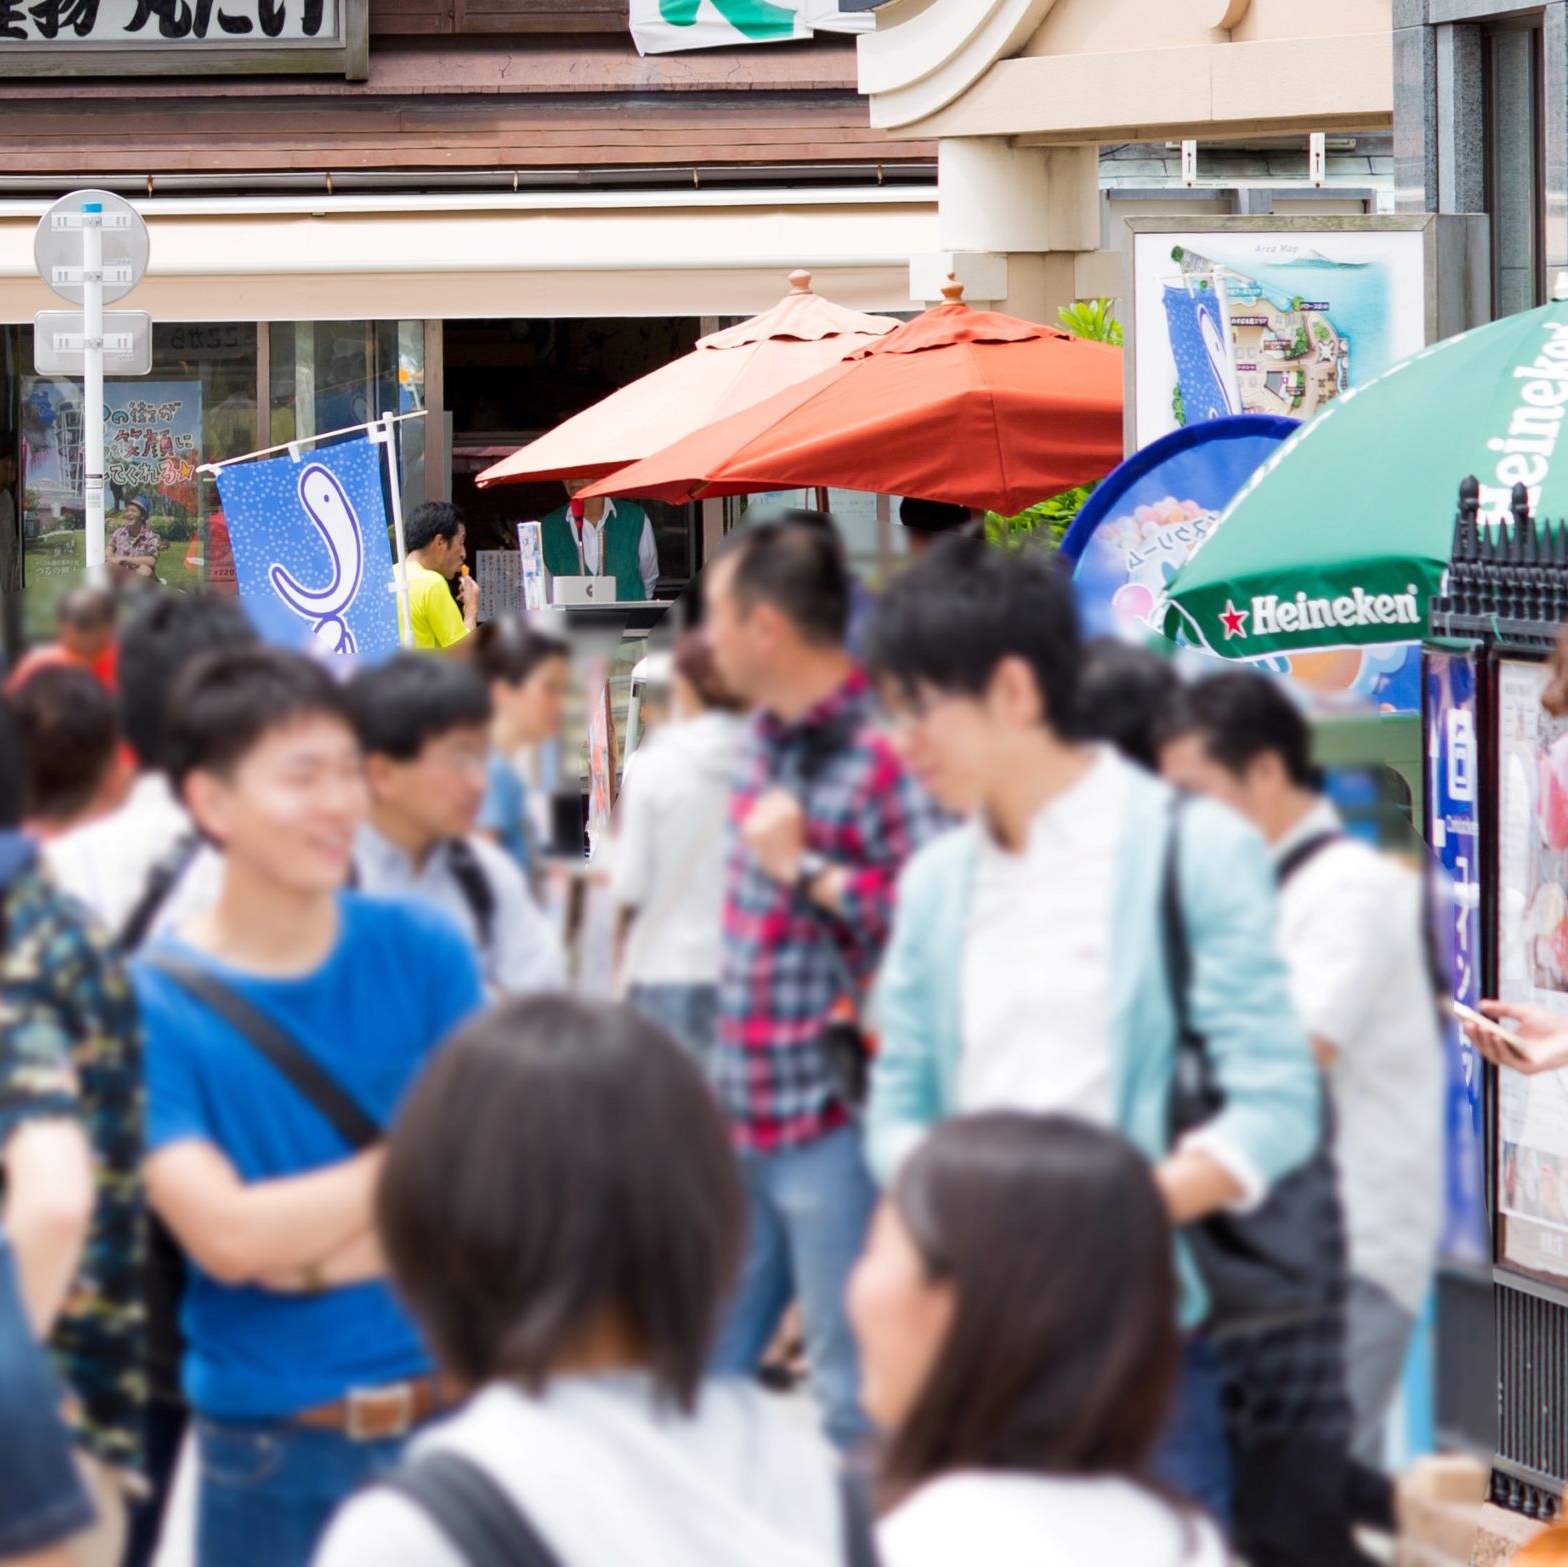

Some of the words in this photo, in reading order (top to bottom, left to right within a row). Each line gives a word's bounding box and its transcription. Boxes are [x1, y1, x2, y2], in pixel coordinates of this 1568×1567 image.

[1254, 244, 1277, 253] Area
[1280, 244, 1299, 254] Map
[103, 461, 177, 488] てくれる
[1251, 585, 1421, 635] Heineken
